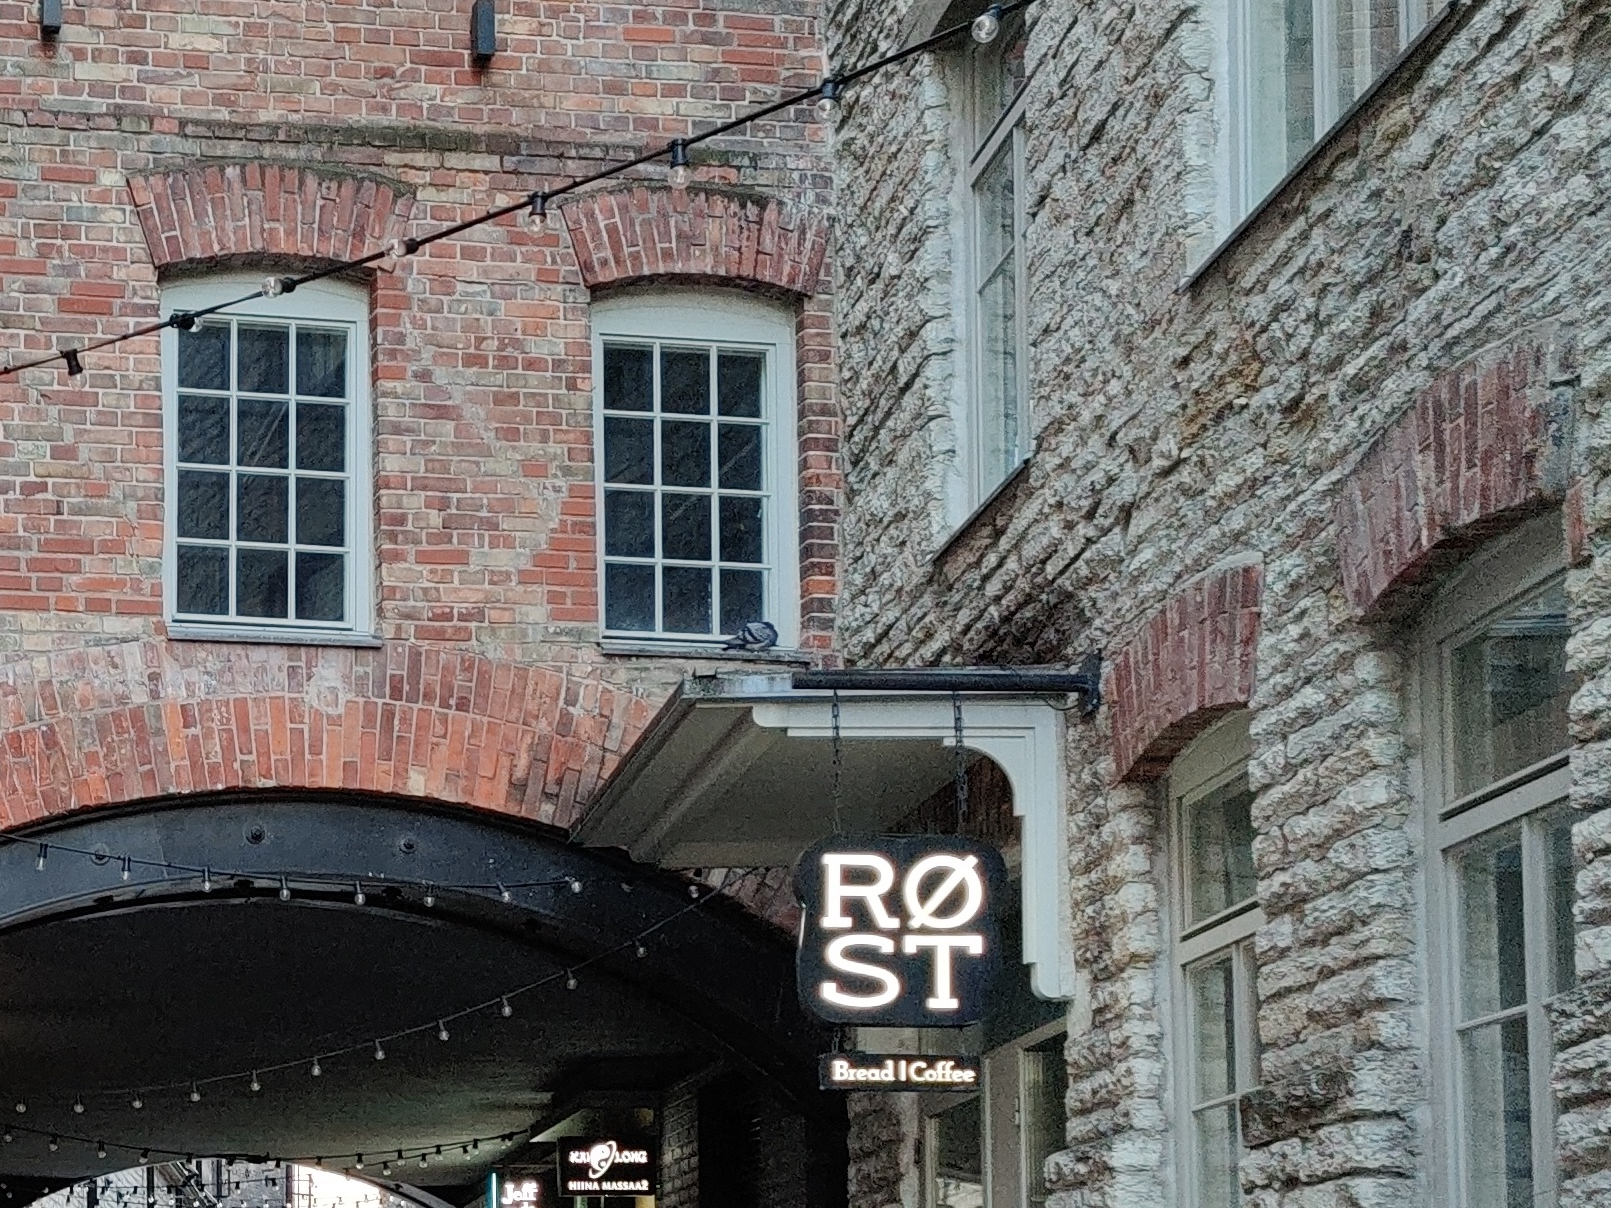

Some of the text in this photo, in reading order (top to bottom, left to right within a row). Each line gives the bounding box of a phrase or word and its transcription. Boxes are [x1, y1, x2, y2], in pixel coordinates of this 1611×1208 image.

[831, 1059, 976, 1083] Bread Coffee
[613, 1150, 648, 1164] LONG
[501, 1180, 539, 1205] Jeff
